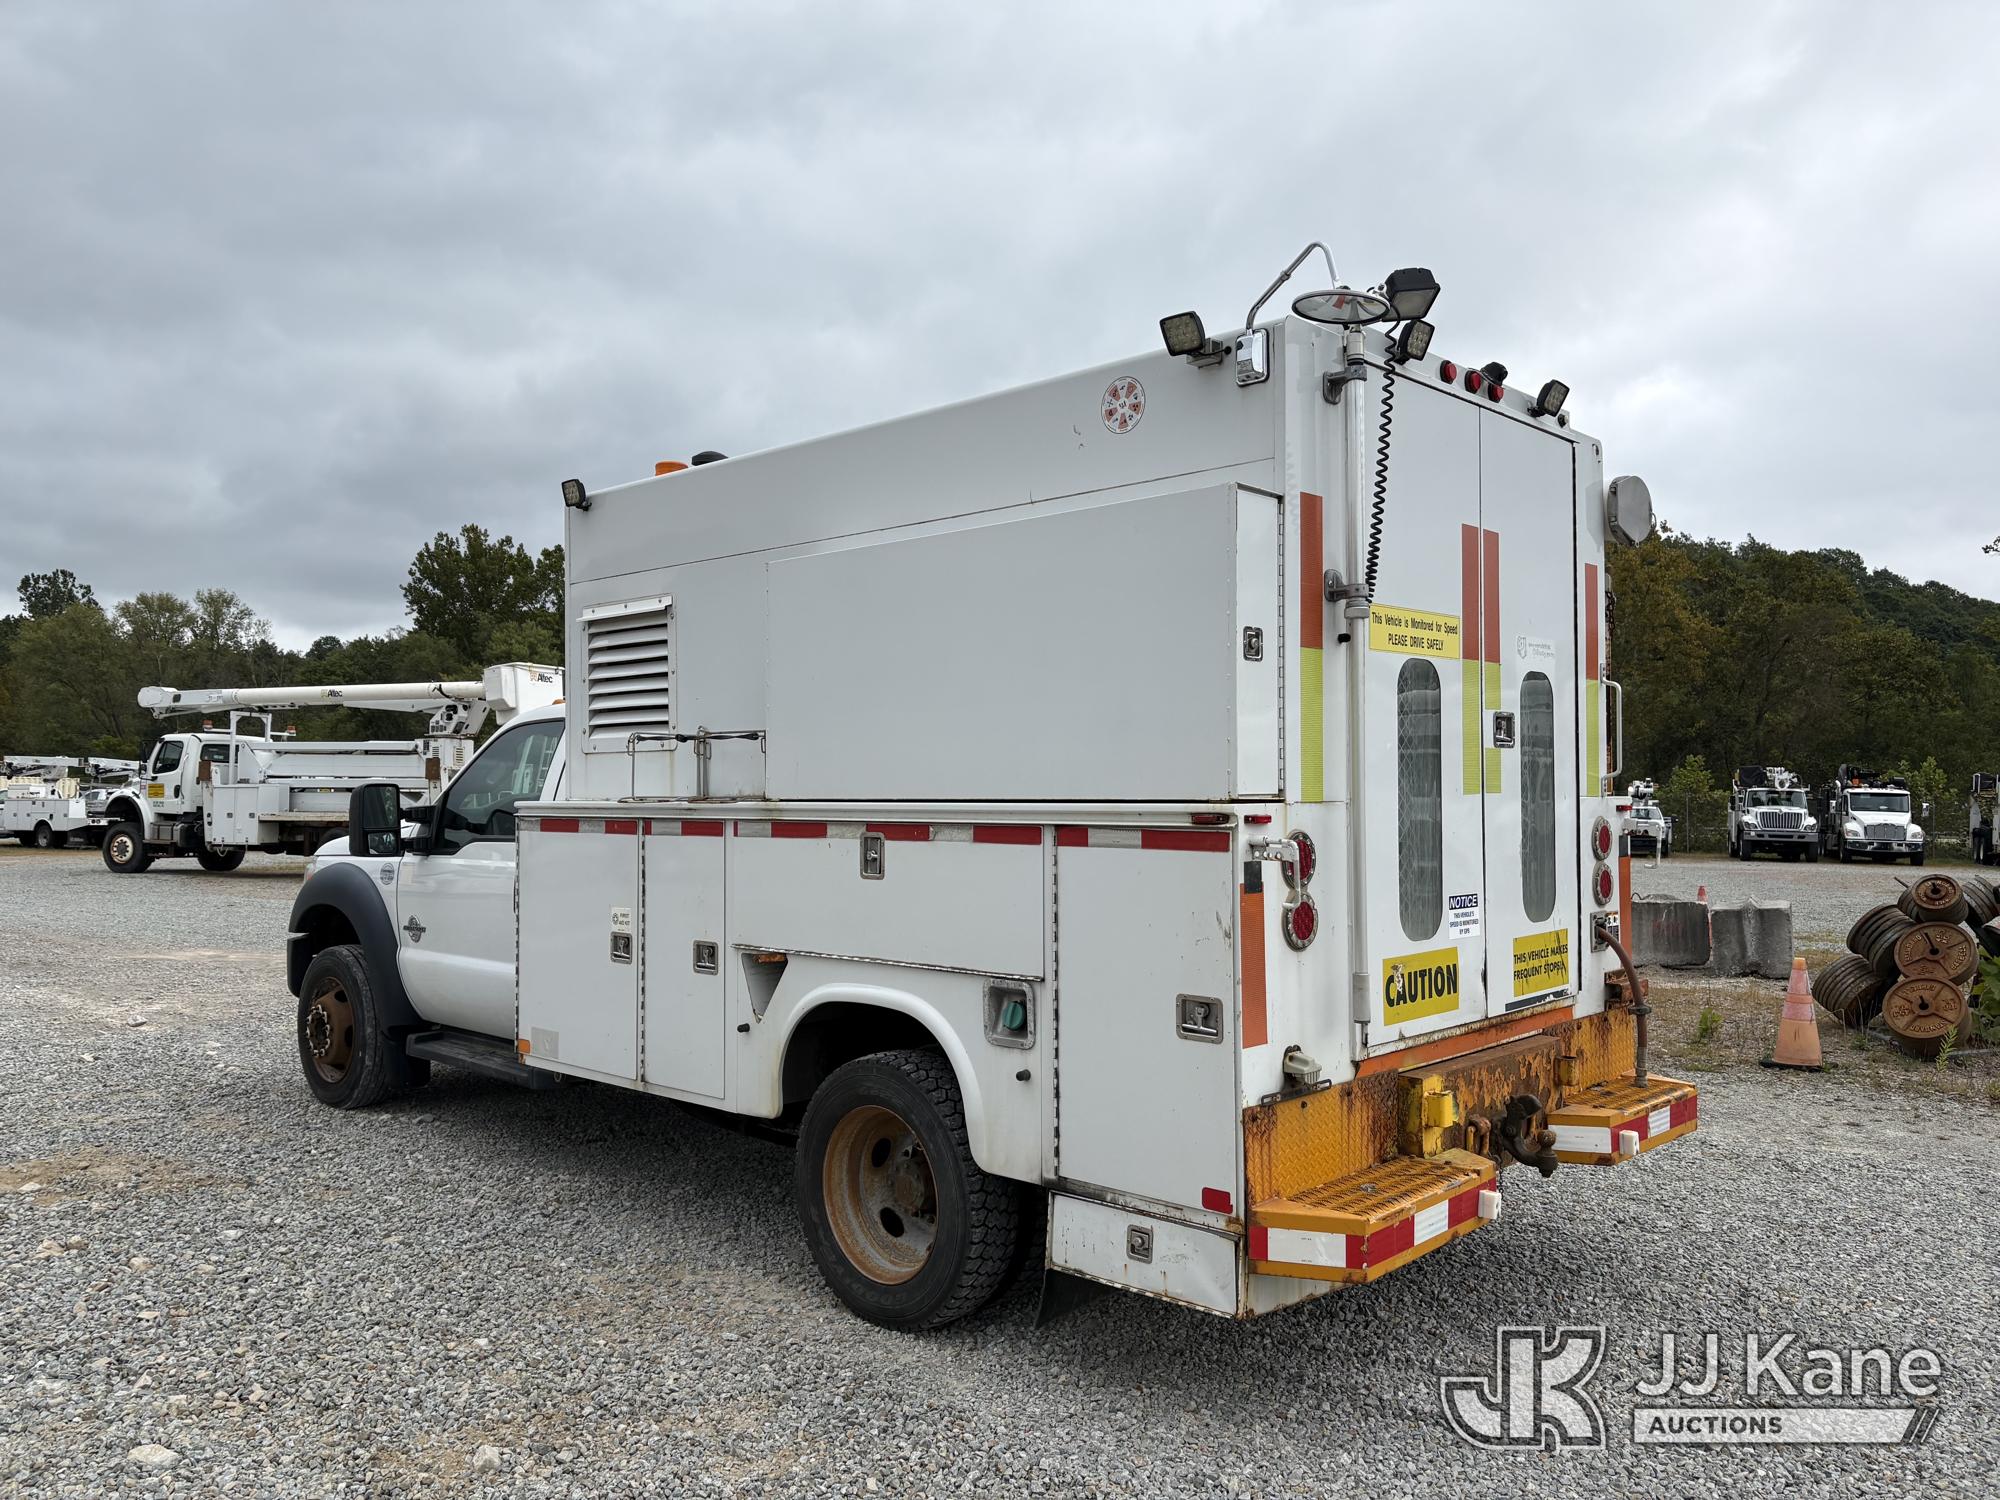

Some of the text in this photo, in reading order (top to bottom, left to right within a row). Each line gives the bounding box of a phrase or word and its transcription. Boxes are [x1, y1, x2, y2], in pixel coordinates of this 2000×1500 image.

[1372, 612, 1382, 624] This
[1385, 614, 1402, 627] Vehicle
[1404, 617, 1408, 628] is
[1411, 618, 1434, 631] Monitored
[1444, 622, 1458, 636] Speed
[1388, 633, 1444, 650] PLEASE DRIVE SAFELY
[538, 673, 553, 683] Altec
[1450, 895, 1477, 909] NOTICE
[1514, 944, 1568, 964] THIS VEHICLE MAKES
[1514, 965, 1542, 980] FREQUENT
[1386, 964, 1458, 1008] CAUTION
